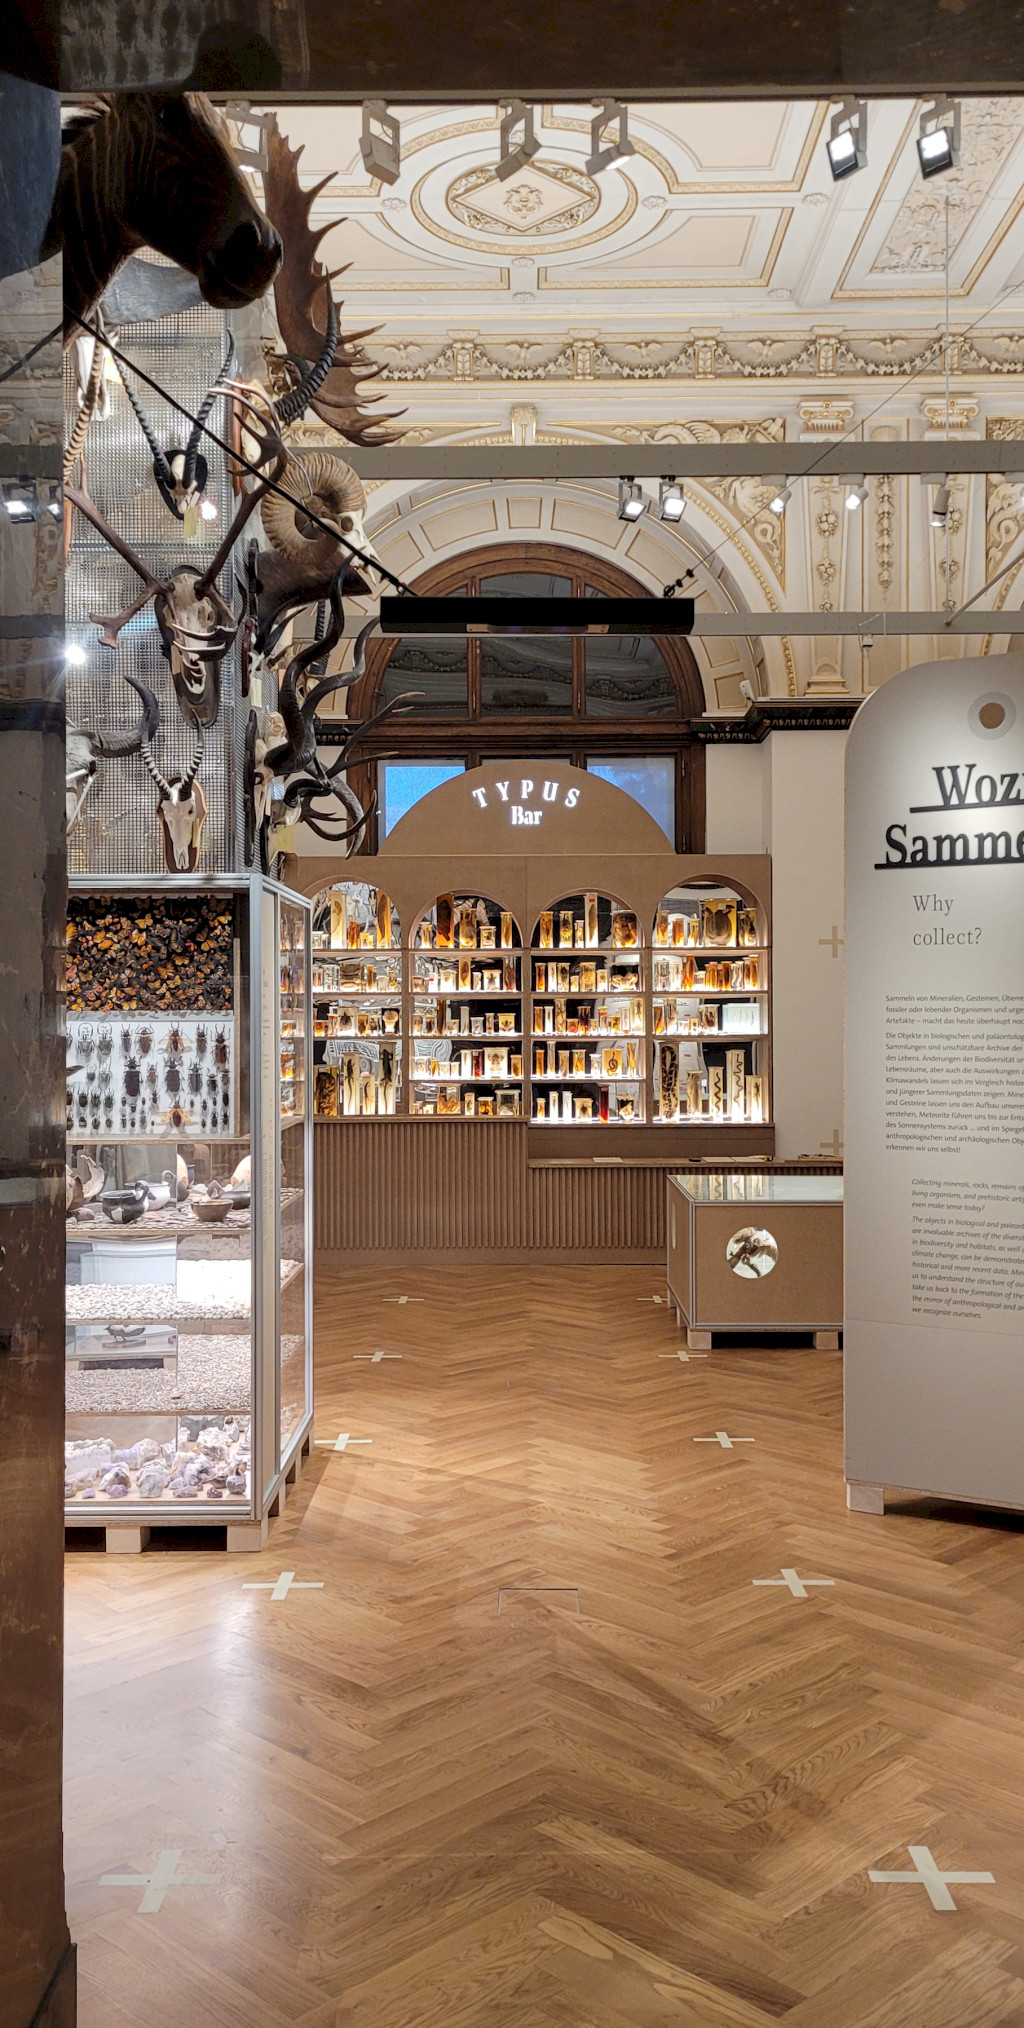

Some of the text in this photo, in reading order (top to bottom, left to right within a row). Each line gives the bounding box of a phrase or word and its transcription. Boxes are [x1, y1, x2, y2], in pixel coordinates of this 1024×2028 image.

[932, 764, 1024, 805] Woz
[472, 780, 580, 808] TYPUS
[511, 805, 542, 825] Bar
[913, 894, 954, 916] Why
[913, 928, 982, 945] collect?
[923, 1055, 960, 1063] Änderungen
[974, 1068, 1019, 1076] Auswirkungen
[927, 1089, 981, 1097] Sammlungsdaten
[898, 1122, 945, 1131] Sonnensystems
[886, 1133, 942, 1141] anthropologischen
[959, 1136, 1009, 1144] archäologischen
[912, 1179, 941, 1188] Collecting
[964, 1205, 985, 1213] today?
[925, 1217, 946, 1225] objects
[955, 1220, 985, 1228] biological
[923, 1228, 954, 1236] invaluable
[982, 1232, 989, 1240] of
[920, 1239, 954, 1249] biodiversity
[970, 1243, 996, 1251] habitats,
[929, 1274, 964, 1283] understand
[977, 1278, 1005, 1286] structure
[1007, 1280, 1014, 1288] of
[971, 1288, 1002, 1297] formation
[1005, 1292, 1011, 1300] of
[945, 1297, 951, 1305] of
[953, 1299, 1002, 1309] anthropological
[923, 1308, 951, 1316] recognize
[953, 1311, 981, 1319] ourselves.
